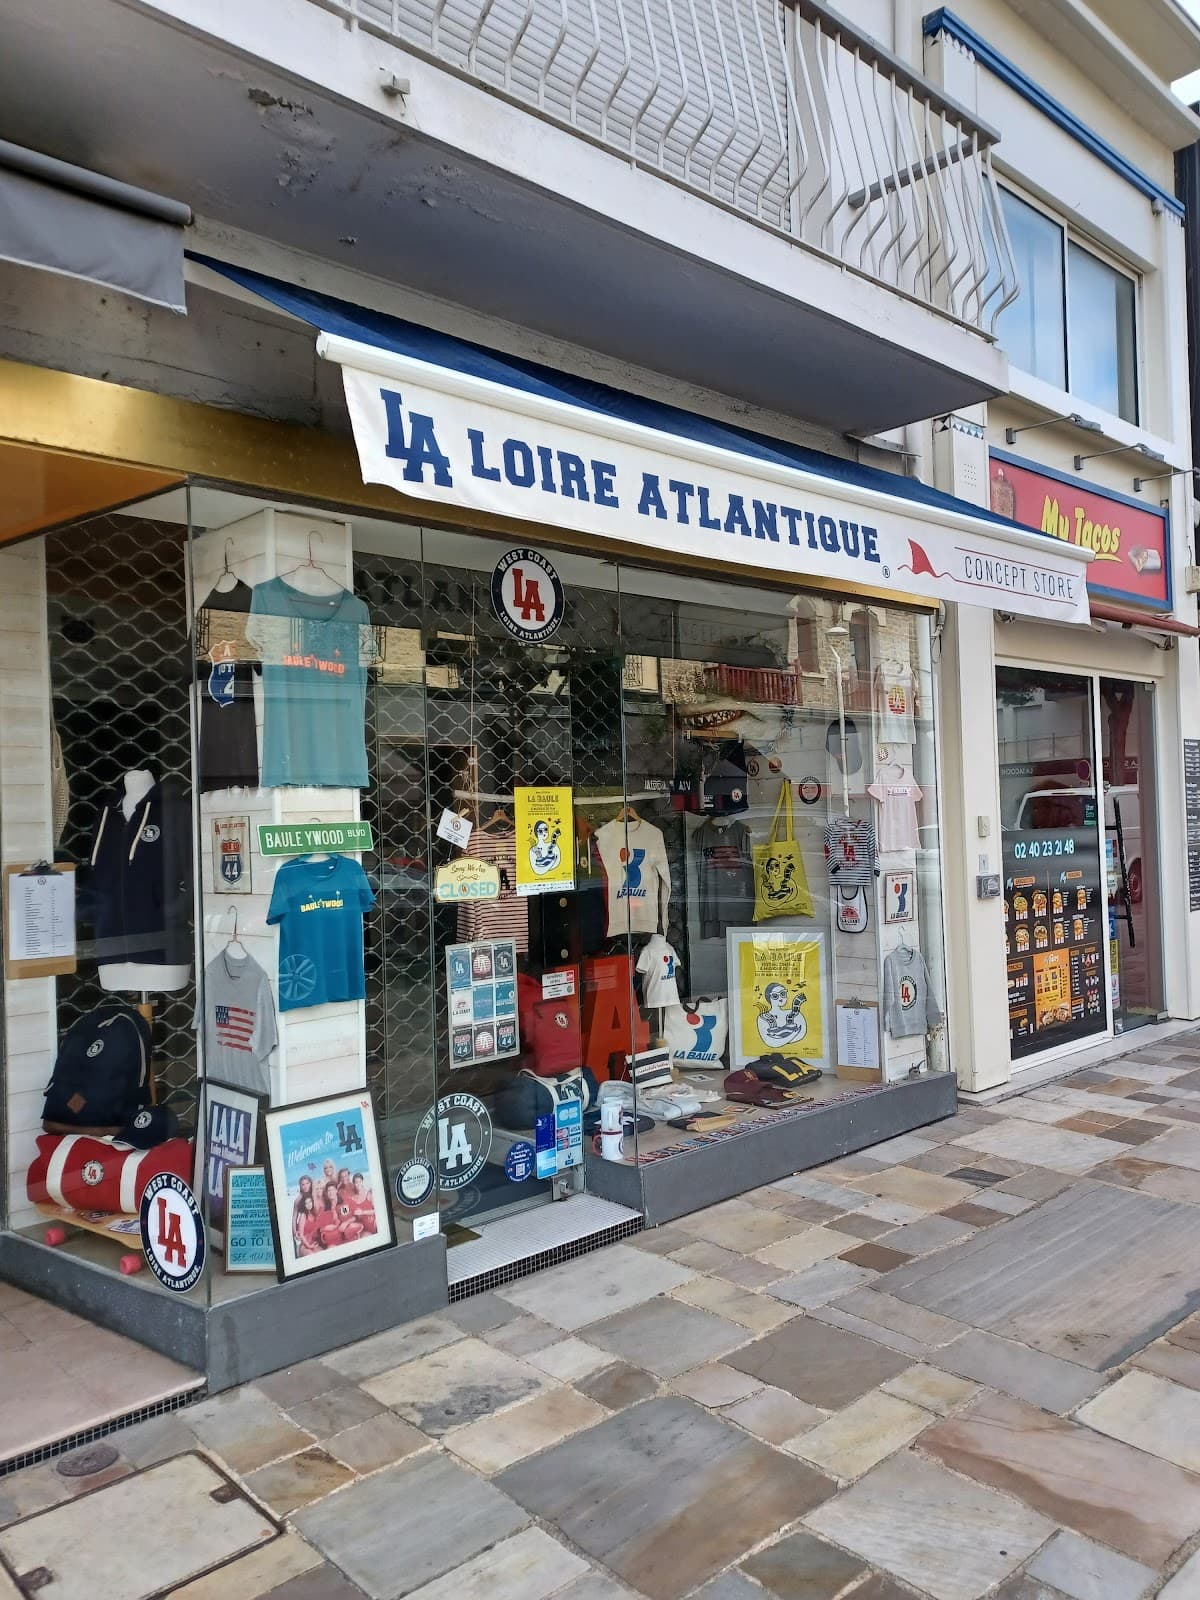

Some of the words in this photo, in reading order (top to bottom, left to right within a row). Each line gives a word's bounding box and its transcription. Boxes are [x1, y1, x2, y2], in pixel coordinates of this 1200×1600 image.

[380, 388, 452, 487] LA
[467, 428, 619, 508] LOIRE
[638, 472, 881, 563] ATLANTIQUE
[498, 549, 524, 572] WEST
[527, 550, 558, 580] COAST
[964, 556, 1027, 590] CONCEPT
[1033, 571, 1073, 599] STORE
[512, 567, 545, 622] LA
[266, 831, 303, 849] BAULE
[305, 829, 344, 846] YWOOD
[347, 829, 366, 838] BLVD
[1014, 842, 1027, 859] 02
[1029, 841, 1040, 857] 40
[1042, 840, 1053, 856] 23
[1055, 839, 1063, 855] 21
[1064, 839, 1075, 854] 48
[225, 862, 238, 879] 44
[439, 881, 497, 898] CLOSED
[673, 1050, 685, 1059] LA
[686, 1051, 718, 1061] BAULE
[454, 1095, 486, 1117] COAST
[336, 1120, 363, 1153] LA
[438, 1117, 473, 1170] LA
[145, 1175, 167, 1201] WEST
[171, 1176, 200, 1216] COAST
[157, 1196, 187, 1269] LA
[231, 1237, 247, 1248] GO
[251, 1237, 264, 1247] TO
